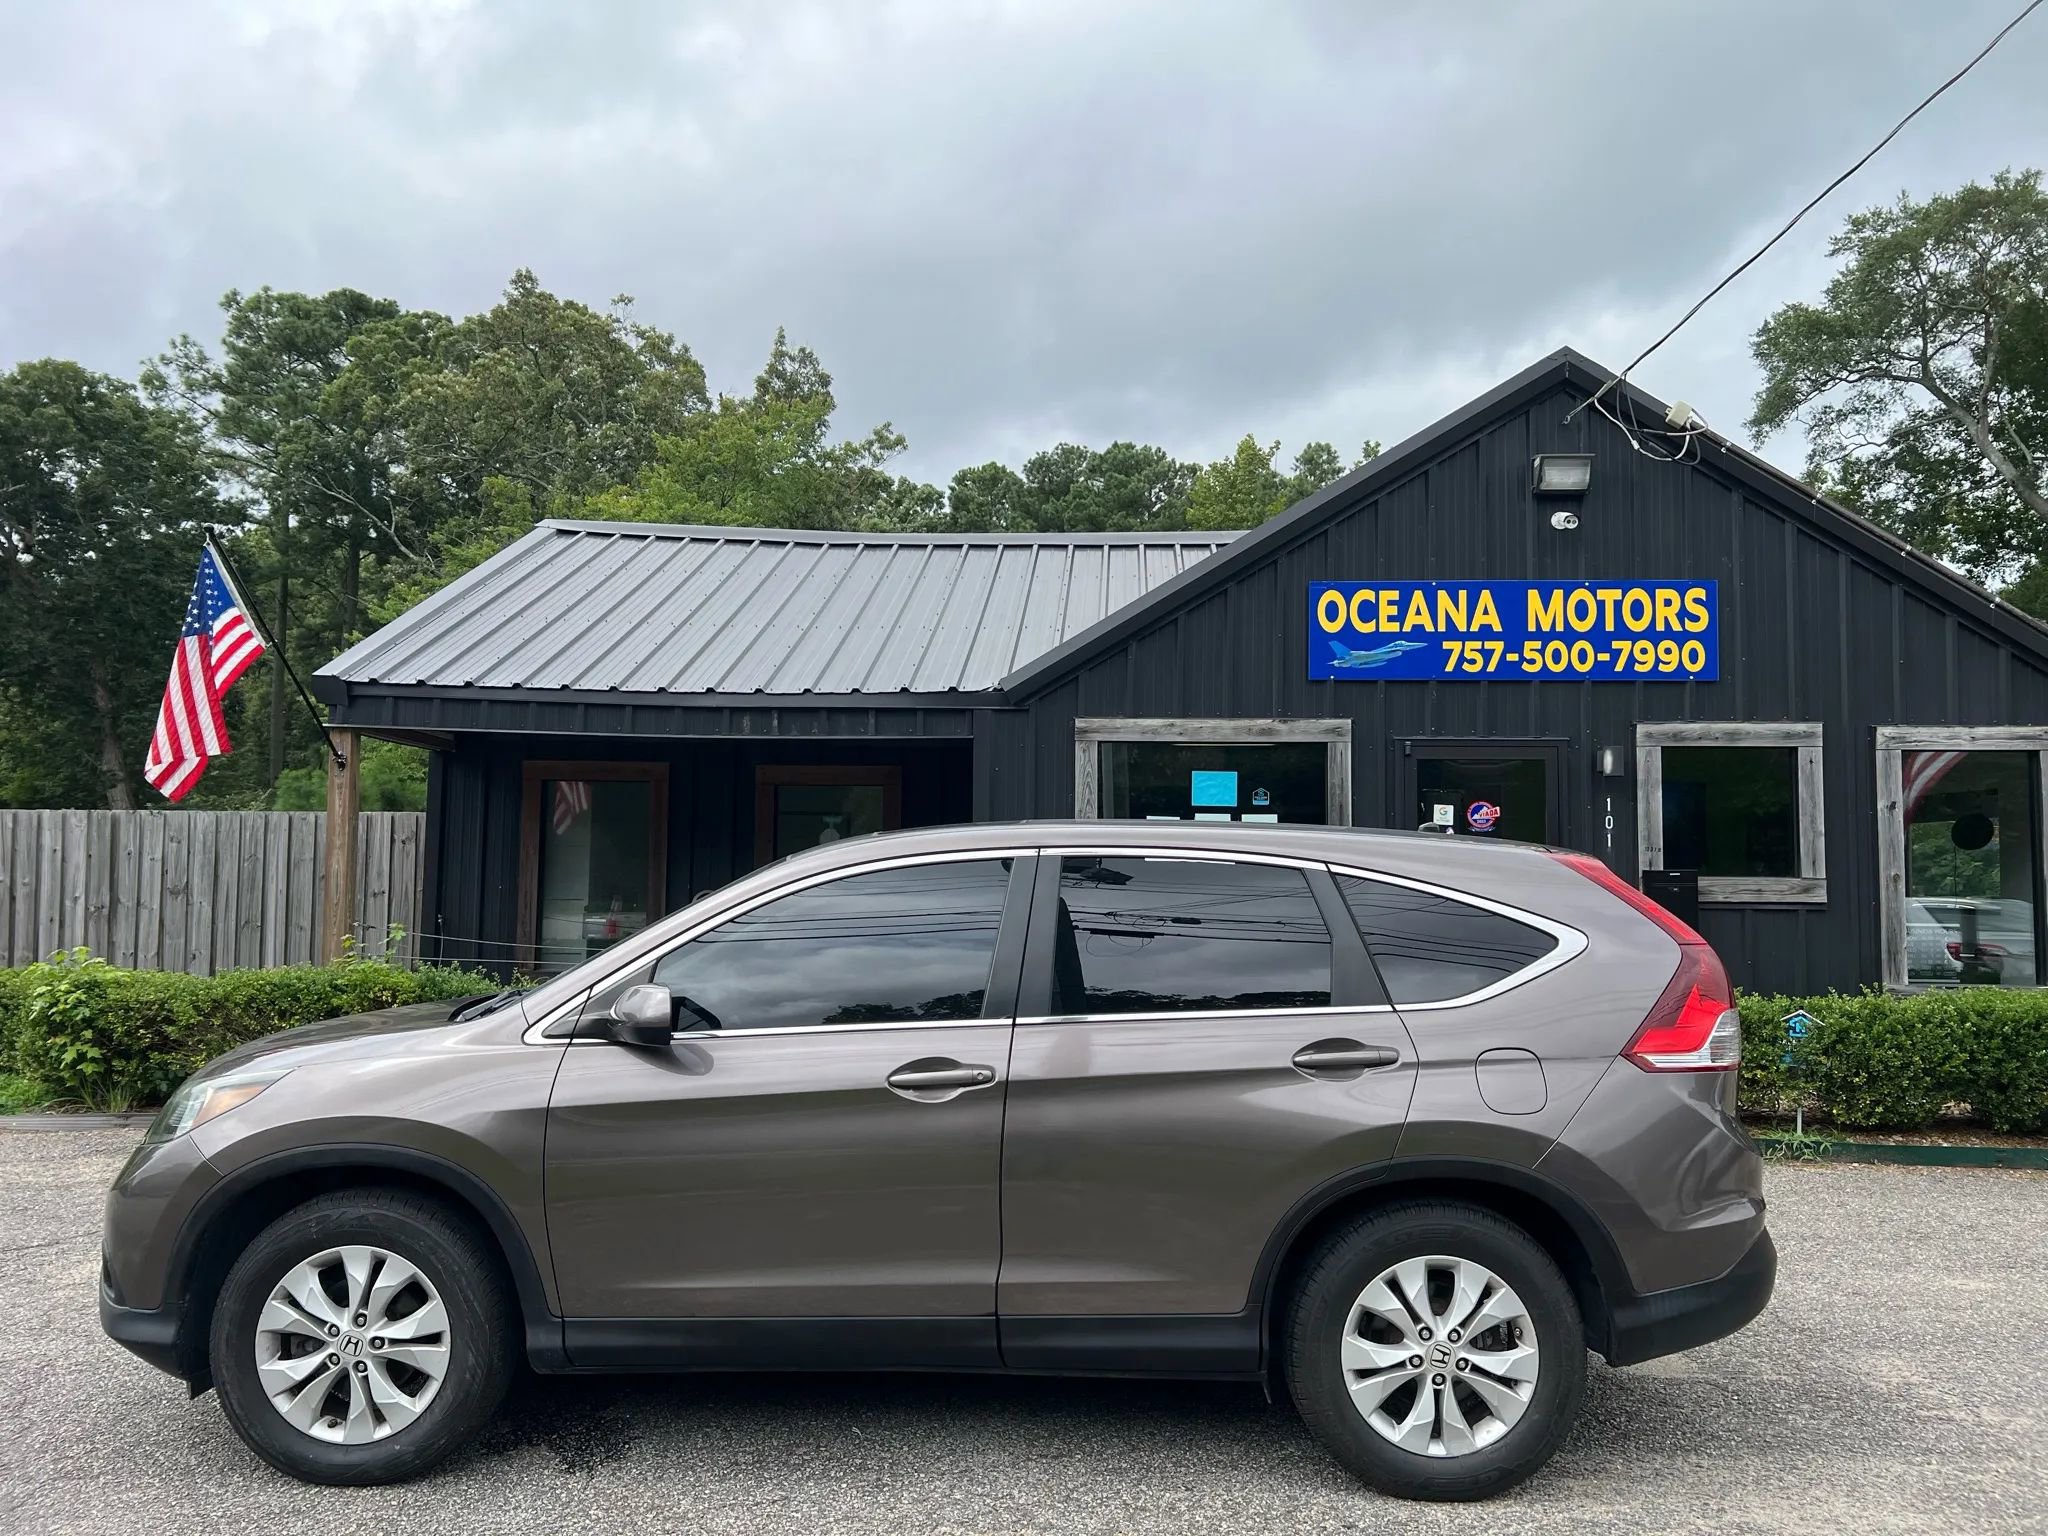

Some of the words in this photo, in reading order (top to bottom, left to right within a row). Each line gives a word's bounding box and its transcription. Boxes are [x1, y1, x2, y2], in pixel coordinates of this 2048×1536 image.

[1317, 589, 1502, 633] OCEANA
[1528, 588, 1709, 633] MOTORS
[1443, 640, 1706, 673] 757-500-7990
[1605, 797, 1614, 848] 101
